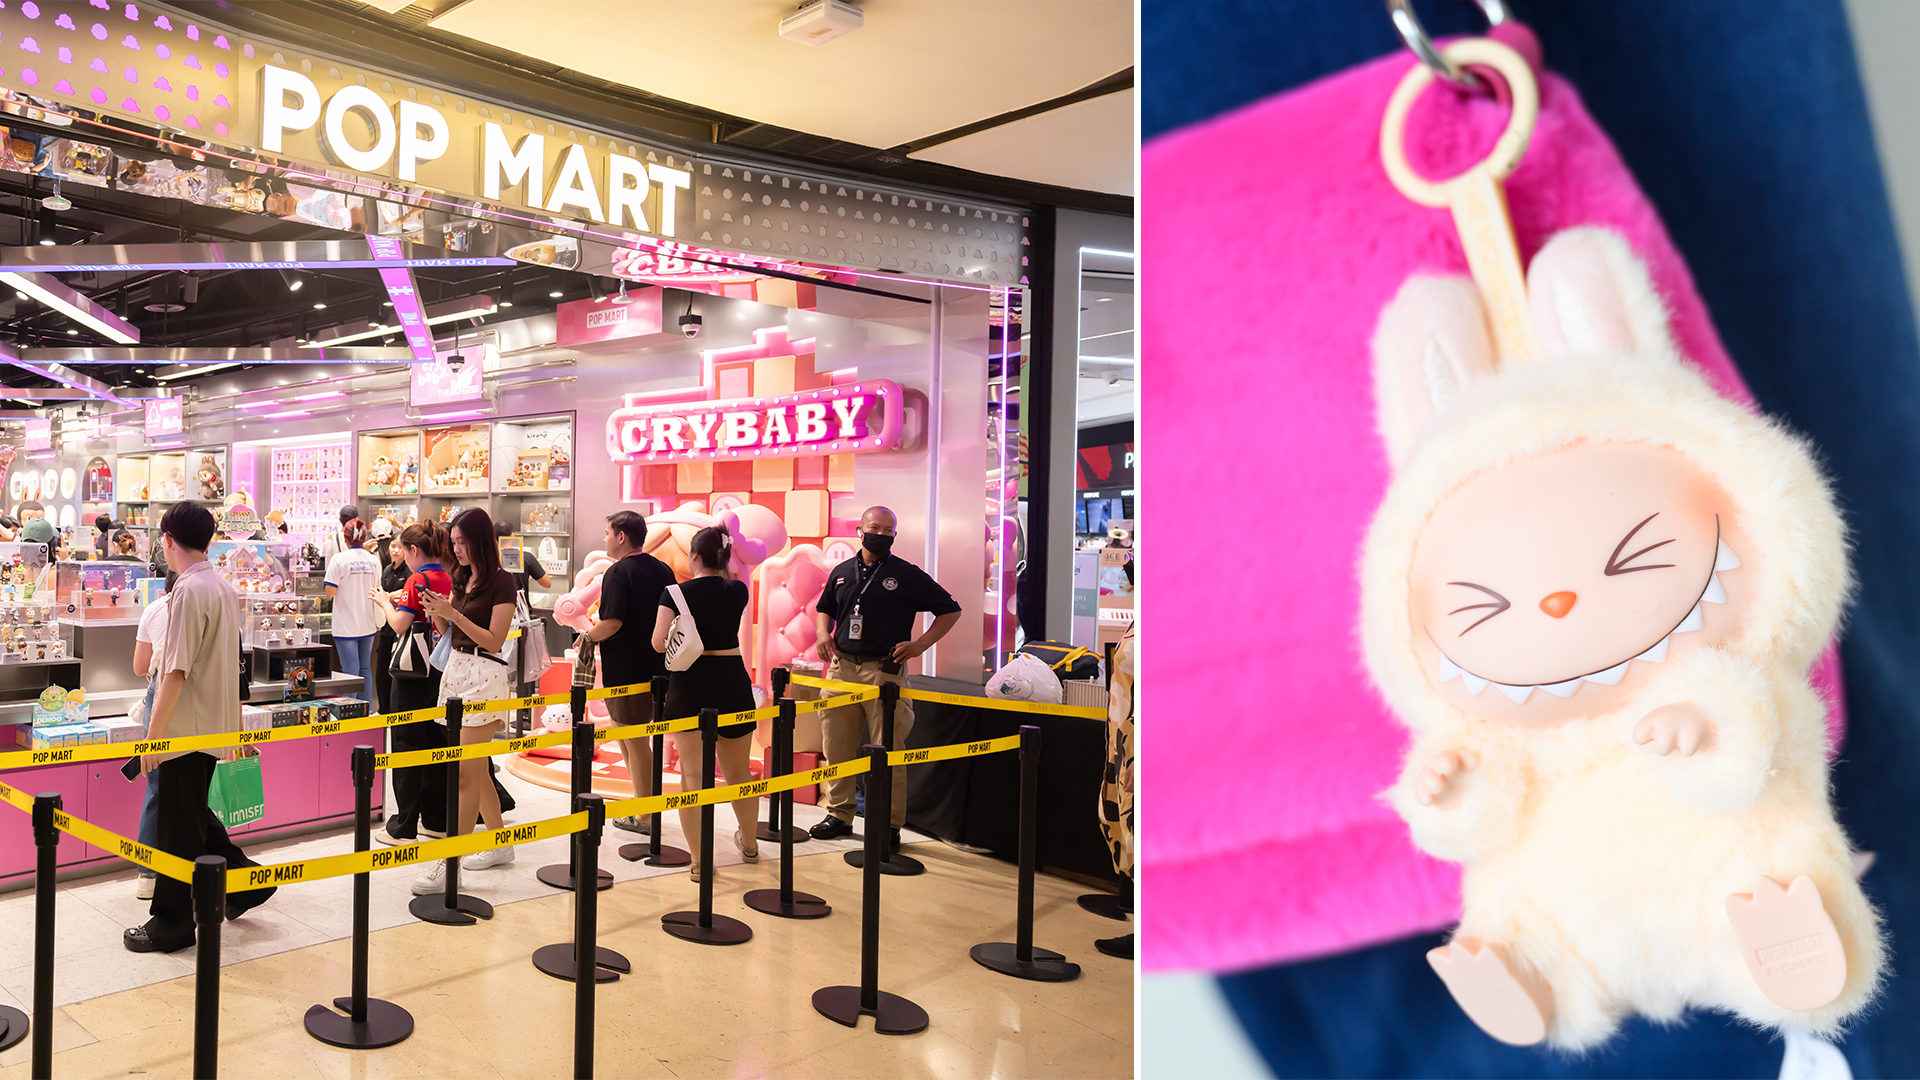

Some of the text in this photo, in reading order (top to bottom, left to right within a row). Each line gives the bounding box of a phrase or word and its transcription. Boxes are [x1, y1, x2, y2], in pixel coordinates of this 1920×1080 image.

[261, 64, 690, 237] POP MART
[588, 309, 626, 326] POP MART
[620, 394, 865, 453] CRYBABY
[463, 702, 487, 712] POP MART
[523, 697, 546, 707] POP MART
[36, 716, 62, 724] DIMOO
[386, 712, 414, 724] POP MART
[311, 722, 341, 734] POP MART
[646, 722, 670, 734] POP MART
[239, 731, 272, 743] POP MART
[134, 740, 171, 753] POP MART
[509, 738, 538, 751] POP MART
[967, 741, 992, 754] POP MART
[33, 750, 73, 763] POP MART
[431, 748, 463, 762] POP MART
[903, 750, 930, 763] POP MART
[375, 756, 390, 768] ART
[811, 766, 839, 782] POP MART
[738, 782, 769, 797] POP MART
[665, 793, 699, 809] POP MART
[54, 812, 70, 830] MART
[494, 825, 538, 846] POP MART
[119, 840, 153, 865] POP MART
[371, 845, 420, 867] POP MART
[249, 863, 305, 885] POP MART
[1760, 936, 1825, 963] POP MART
